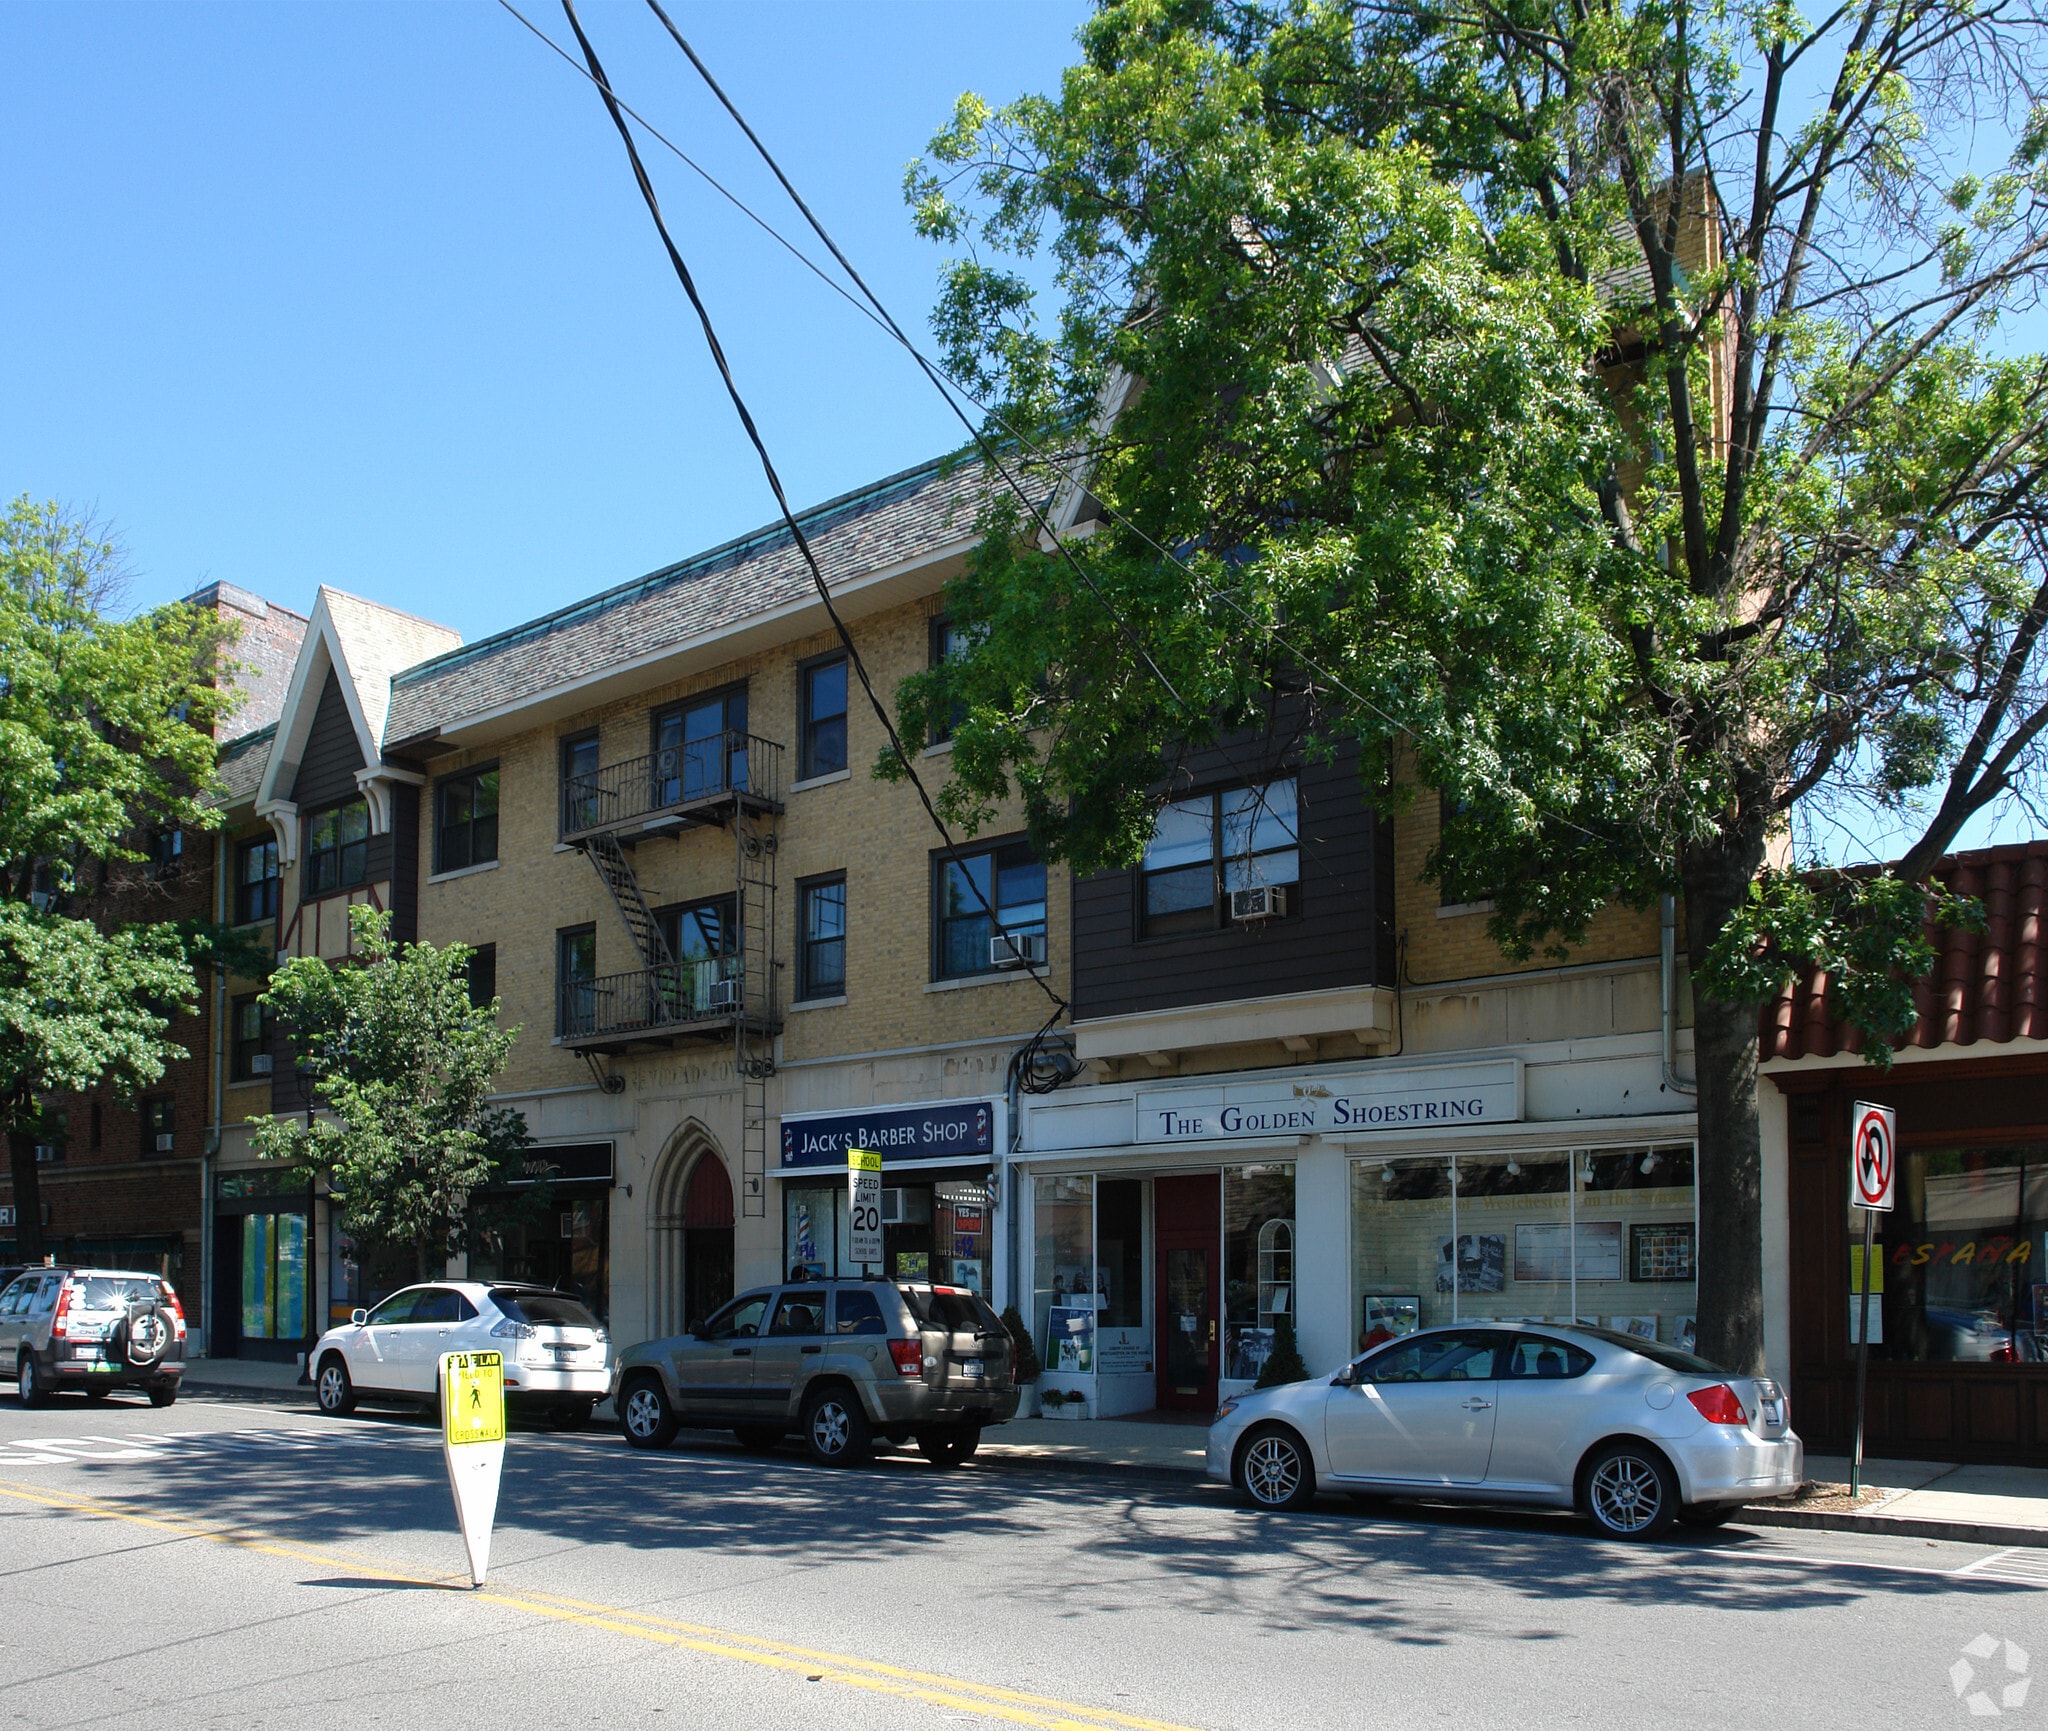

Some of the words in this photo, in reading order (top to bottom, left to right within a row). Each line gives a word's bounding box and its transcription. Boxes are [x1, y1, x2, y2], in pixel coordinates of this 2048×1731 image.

[1159, 1110, 1203, 1136] THE
[1220, 1106, 1315, 1132] GOLDEN
[1333, 1098, 1485, 1125] SHOESTRING
[801, 1132, 853, 1154] JACK'S
[858, 1126, 916, 1149] BARBER
[922, 1120, 968, 1143] SHOP
[851, 1154, 879, 1168] SCHOOL
[853, 1178, 879, 1190] SPEED
[855, 1192, 876, 1204] LIMIT
[853, 1206, 879, 1232] 20
[958, 1207, 970, 1218] YES
[956, 1218, 980, 1231] OPEN
[1892, 1235, 2032, 1266] ESPAÑA
[479, 1353, 500, 1366] LAW
[483, 1369, 493, 1378] TO
[455, 1428, 500, 1440] CROSSWALK
